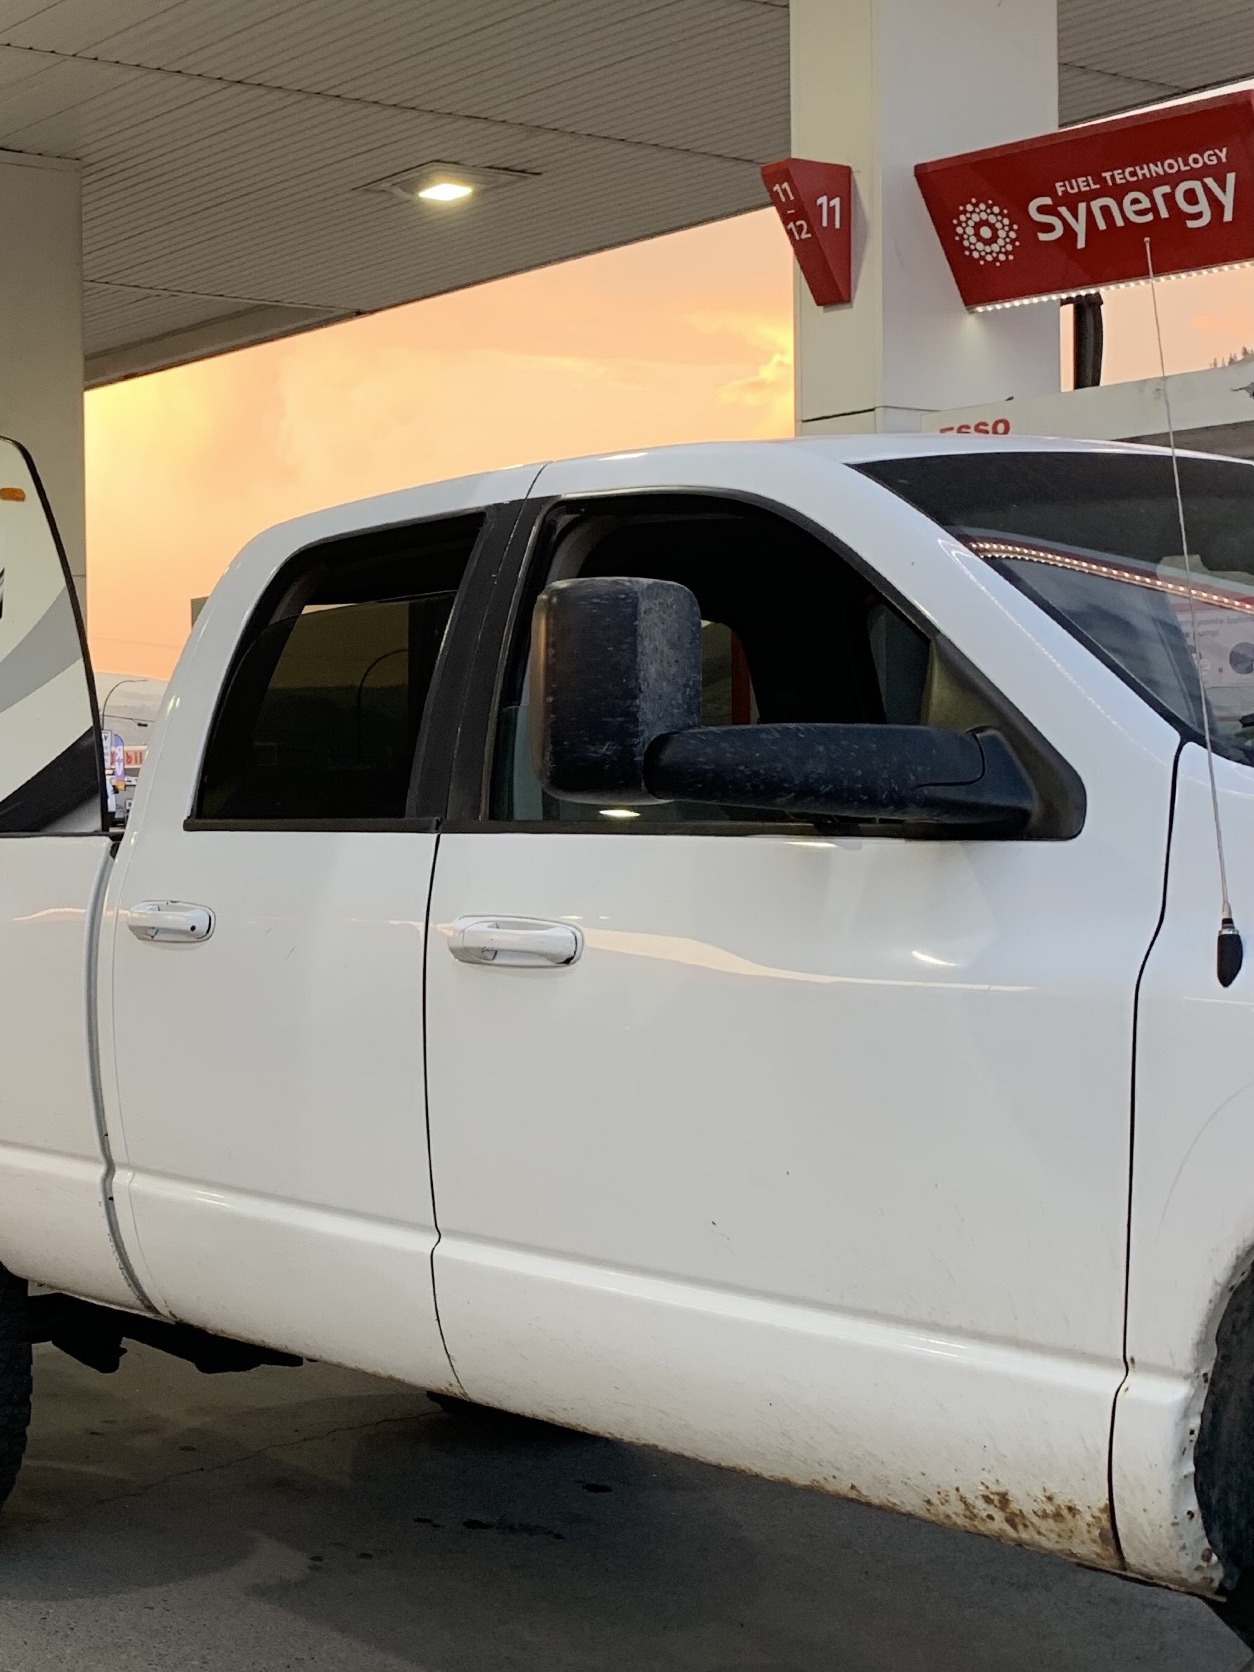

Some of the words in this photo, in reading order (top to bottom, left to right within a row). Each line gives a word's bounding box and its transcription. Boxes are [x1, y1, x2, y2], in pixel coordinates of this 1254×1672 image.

[1054, 176, 1101, 197] FUEL
[1101, 147, 1228, 186] TECHNOLOGY
[772, 181, 795, 202] 11
[816, 194, 841, 229] 11
[1028, 172, 1236, 250] Synergy
[787, 219, 812, 241] 12
